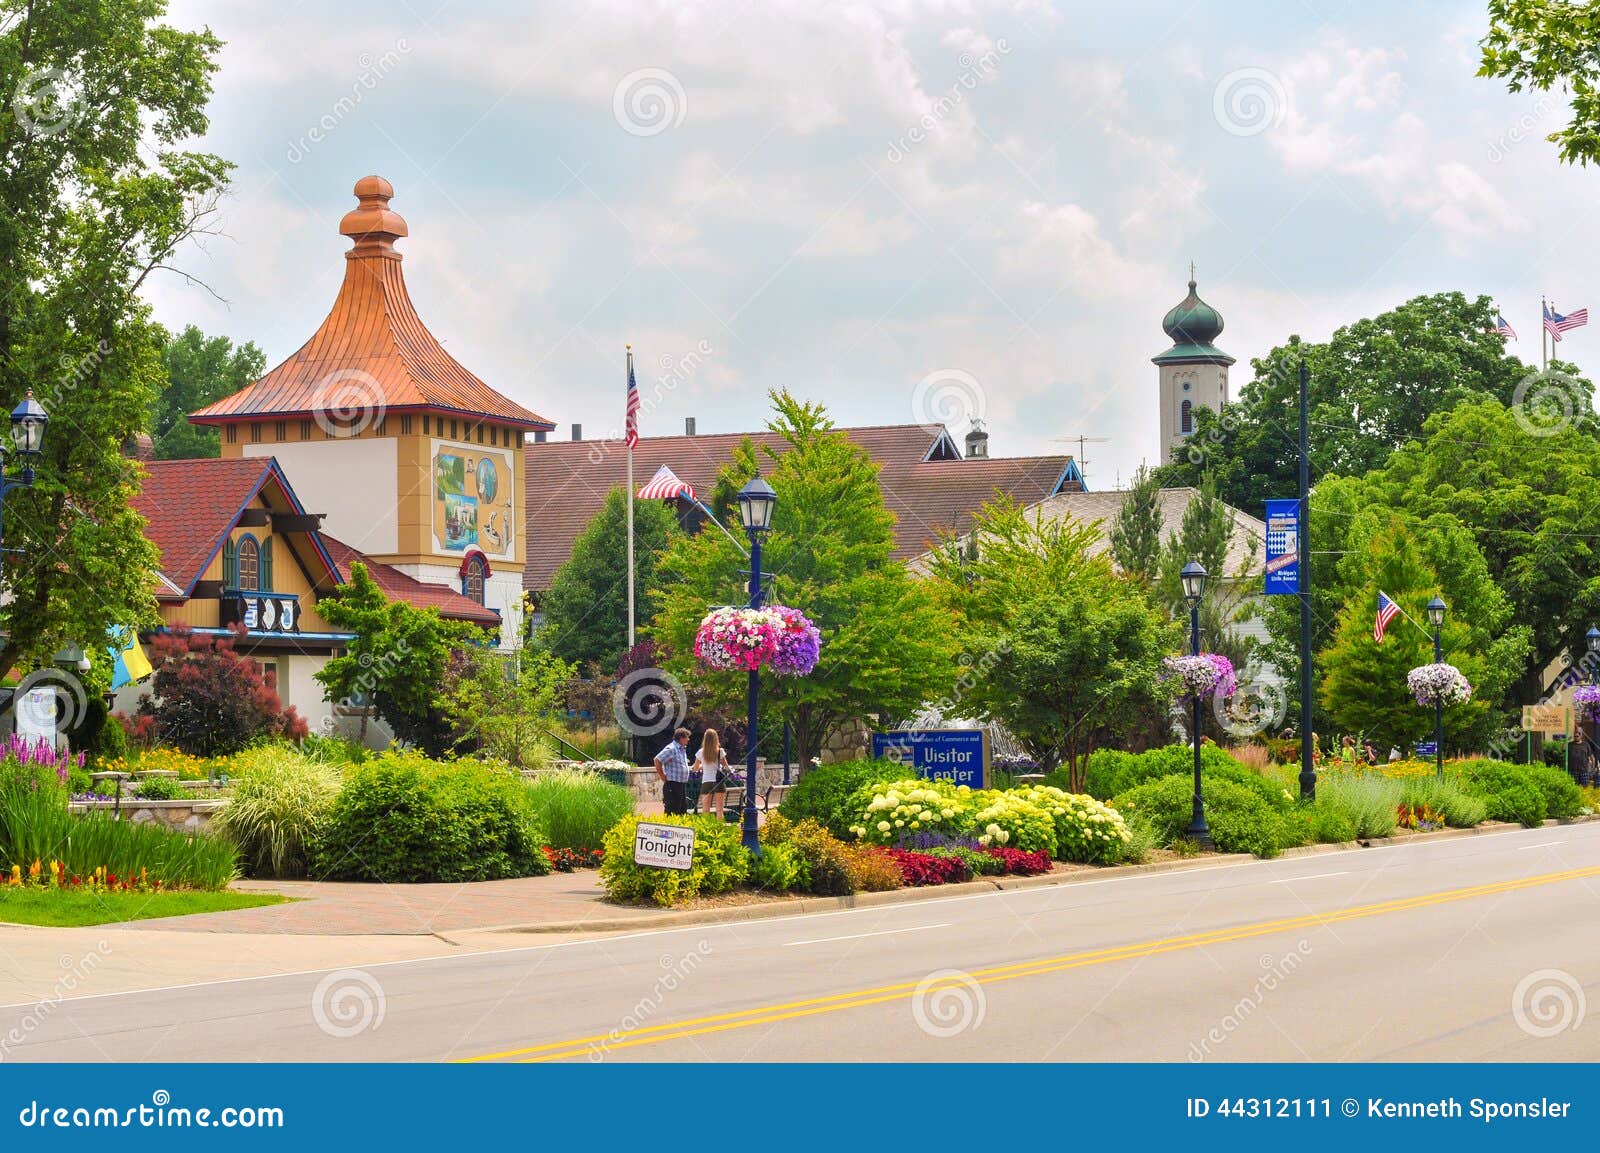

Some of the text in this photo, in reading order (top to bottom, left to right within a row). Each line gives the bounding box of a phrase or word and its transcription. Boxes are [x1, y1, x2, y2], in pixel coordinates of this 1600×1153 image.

[924, 747, 973, 763] Visitor
[922, 766, 975, 783] Center
[637, 836, 692, 858] Tonight
